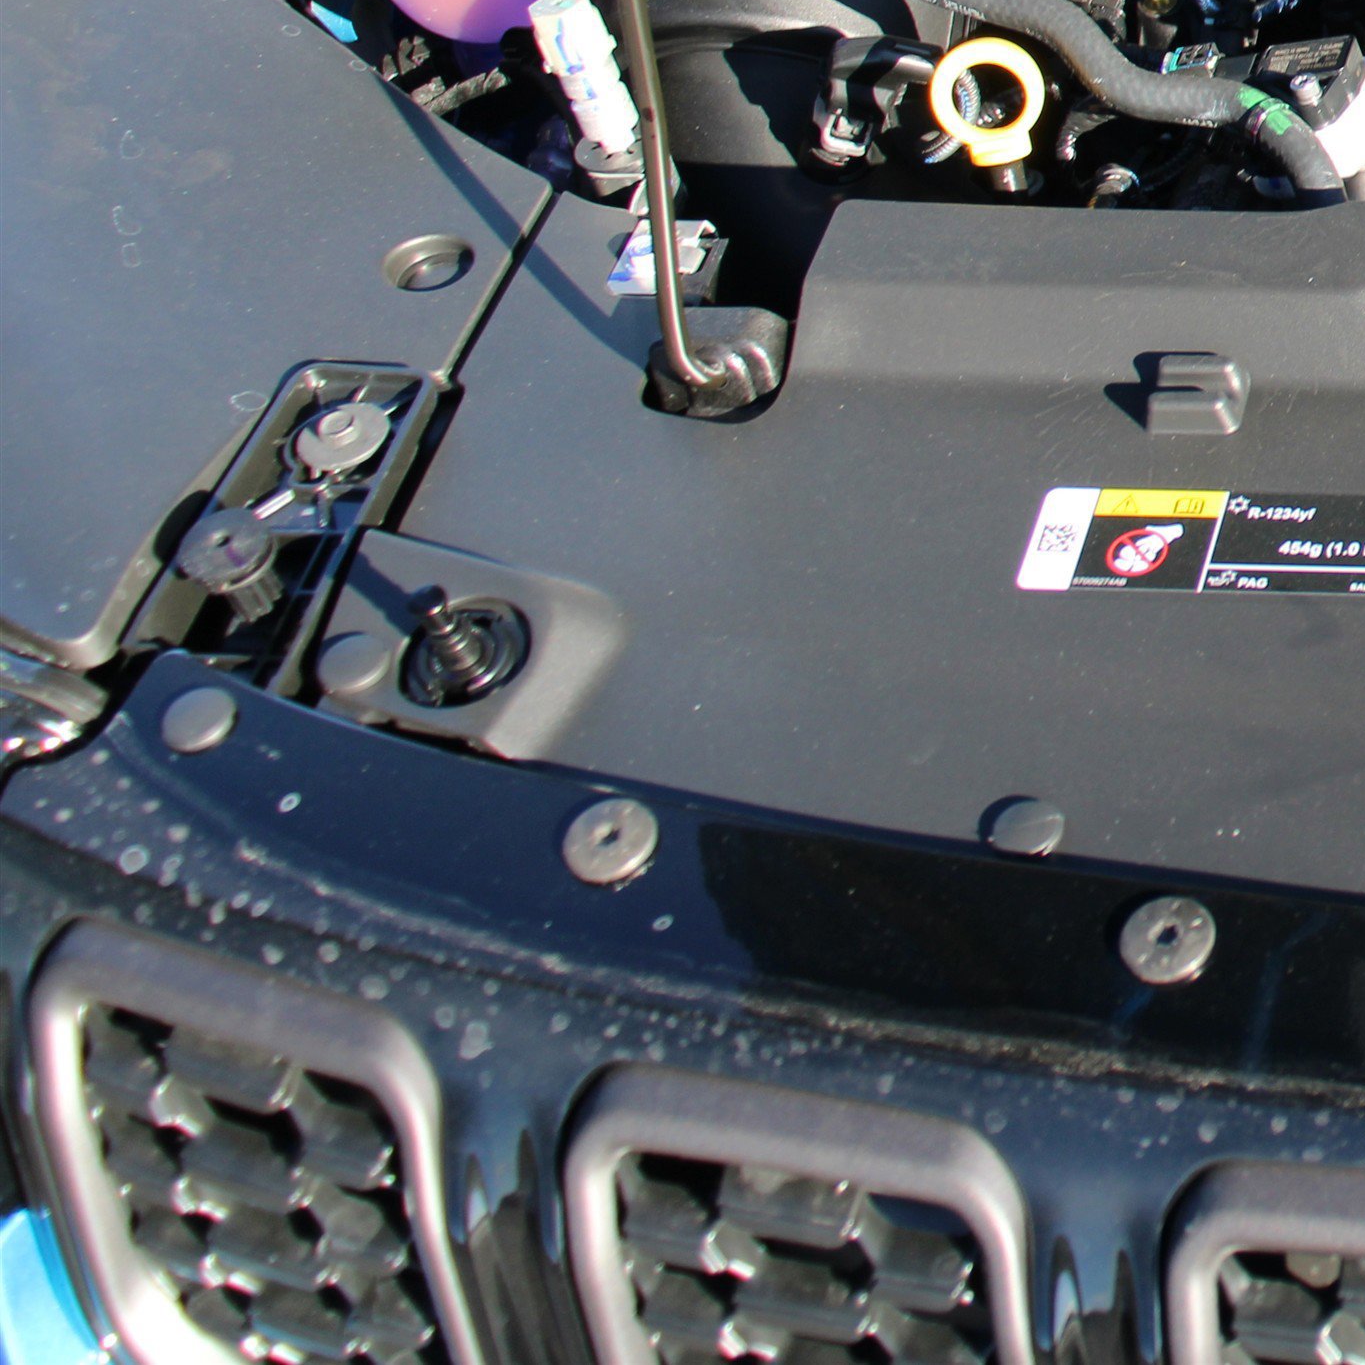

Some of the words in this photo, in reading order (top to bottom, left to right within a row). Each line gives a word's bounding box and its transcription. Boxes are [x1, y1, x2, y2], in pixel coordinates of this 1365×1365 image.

[1247, 505, 1317, 524] R-1234yf
[1278, 540, 1323, 559] 454g
[1325, 541, 1360, 560] (1.0
[1236, 576, 1269, 589] PAG
